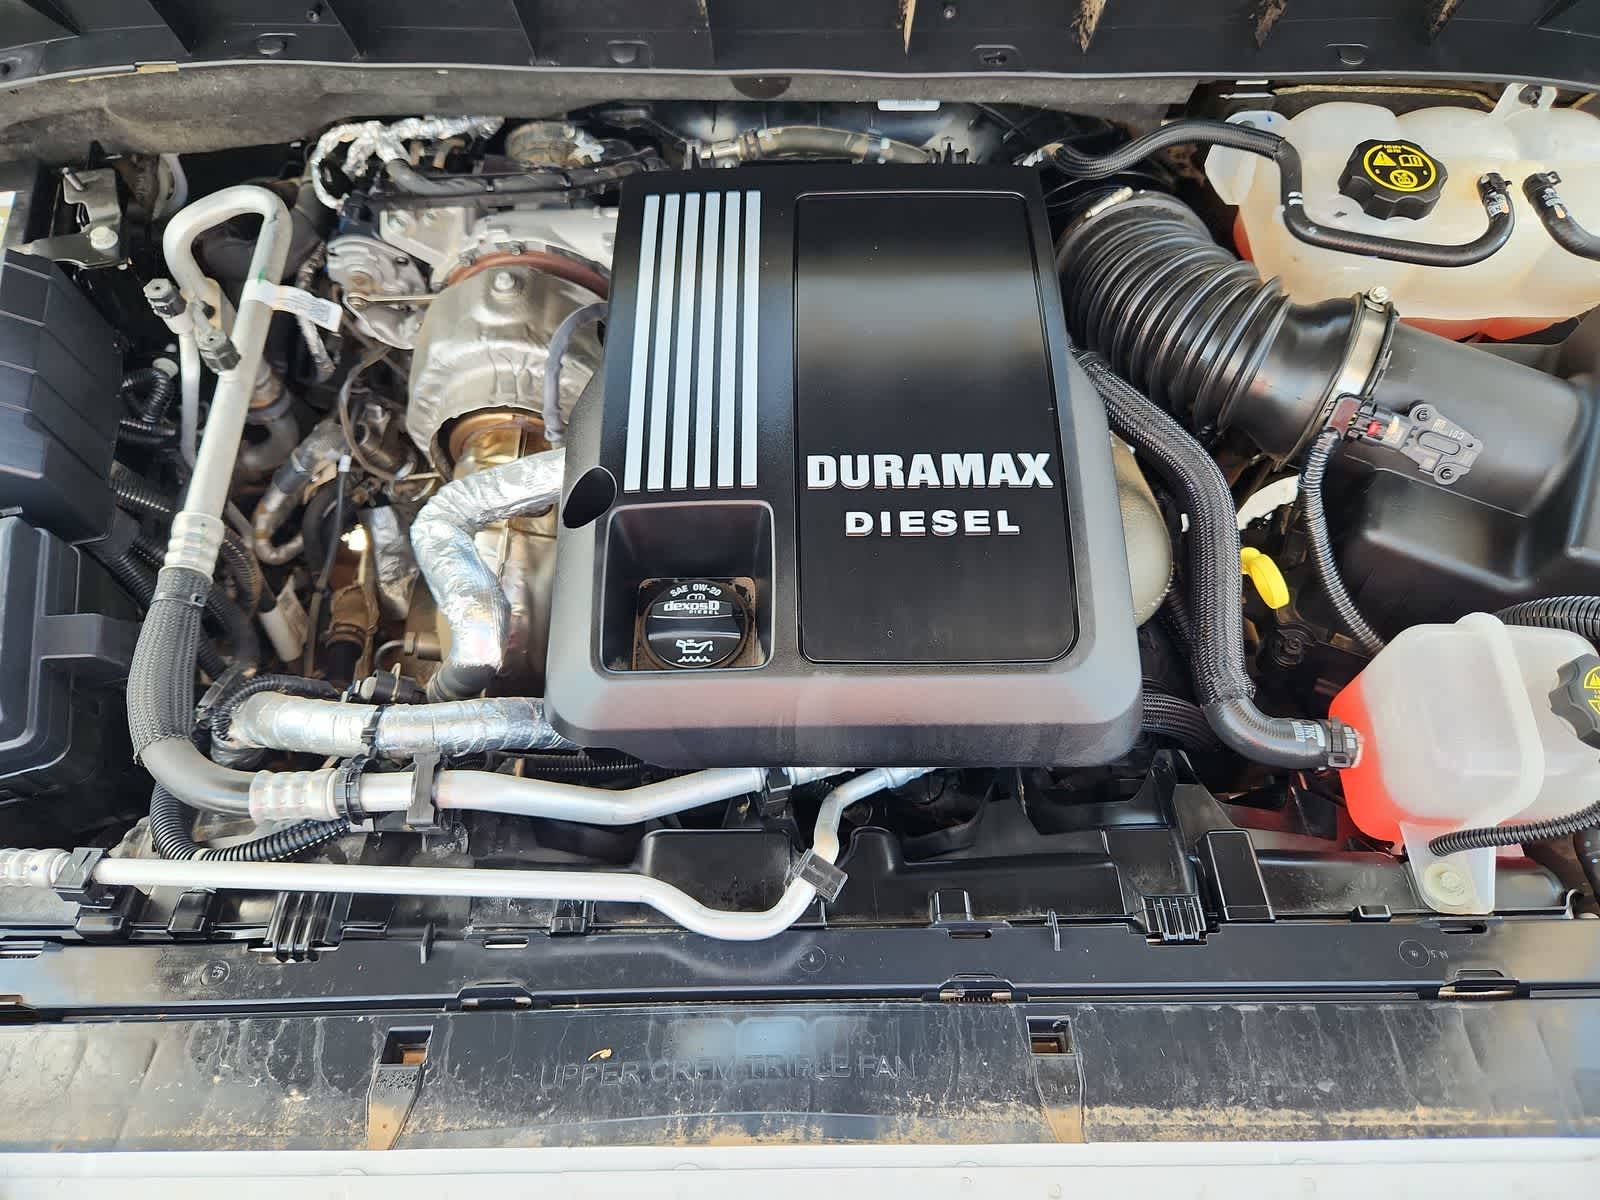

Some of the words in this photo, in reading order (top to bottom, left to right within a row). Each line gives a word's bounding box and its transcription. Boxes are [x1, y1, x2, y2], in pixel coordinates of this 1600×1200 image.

[806, 453, 1054, 490] DURAMAX
[845, 509, 1020, 537] DIESEL
[669, 584, 689, 597] SAE
[692, 583, 722, 597] 0W-20
[540, 1060, 641, 1090] UPPER
[858, 1053, 917, 1080] FAN
